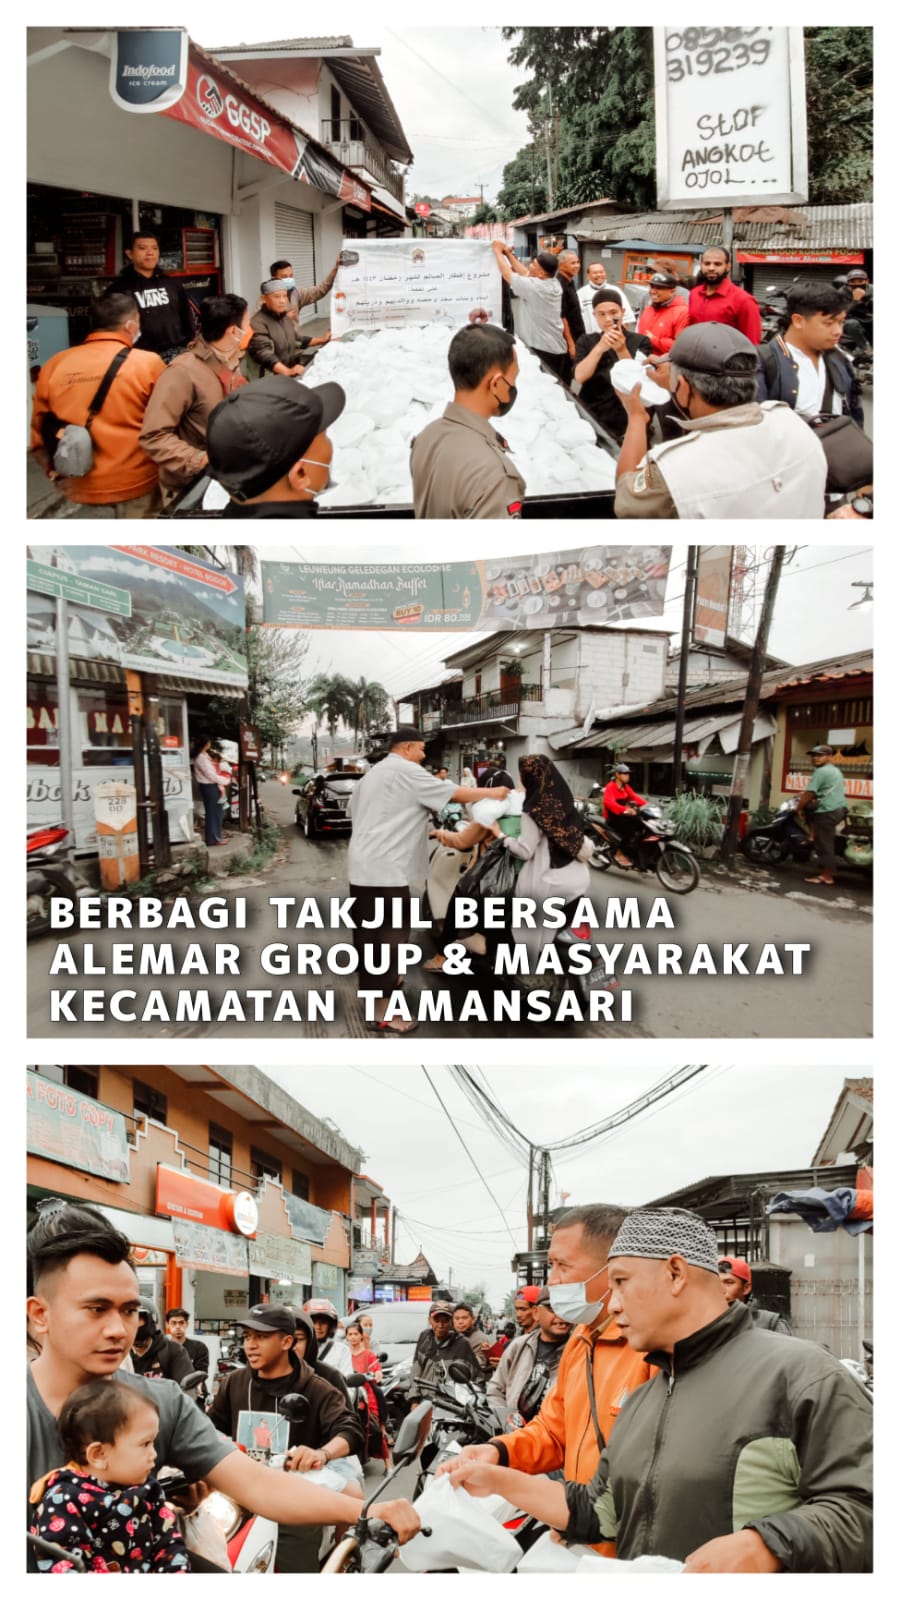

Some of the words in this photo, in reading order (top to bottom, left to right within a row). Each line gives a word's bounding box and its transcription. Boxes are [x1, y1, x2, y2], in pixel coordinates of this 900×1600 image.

[666, 39, 771, 82] 319239
[122, 64, 176, 79] Indofood
[225, 94, 271, 144] GGSP
[134, 287, 169, 309] VANS
[336, 576, 394, 597] Ramadhan
[396, 607, 411, 617] BUY
[424, 614, 441, 623] IDR
[37, 1081, 78, 1118] FOTO
[80, 1101, 116, 1136] COPY
